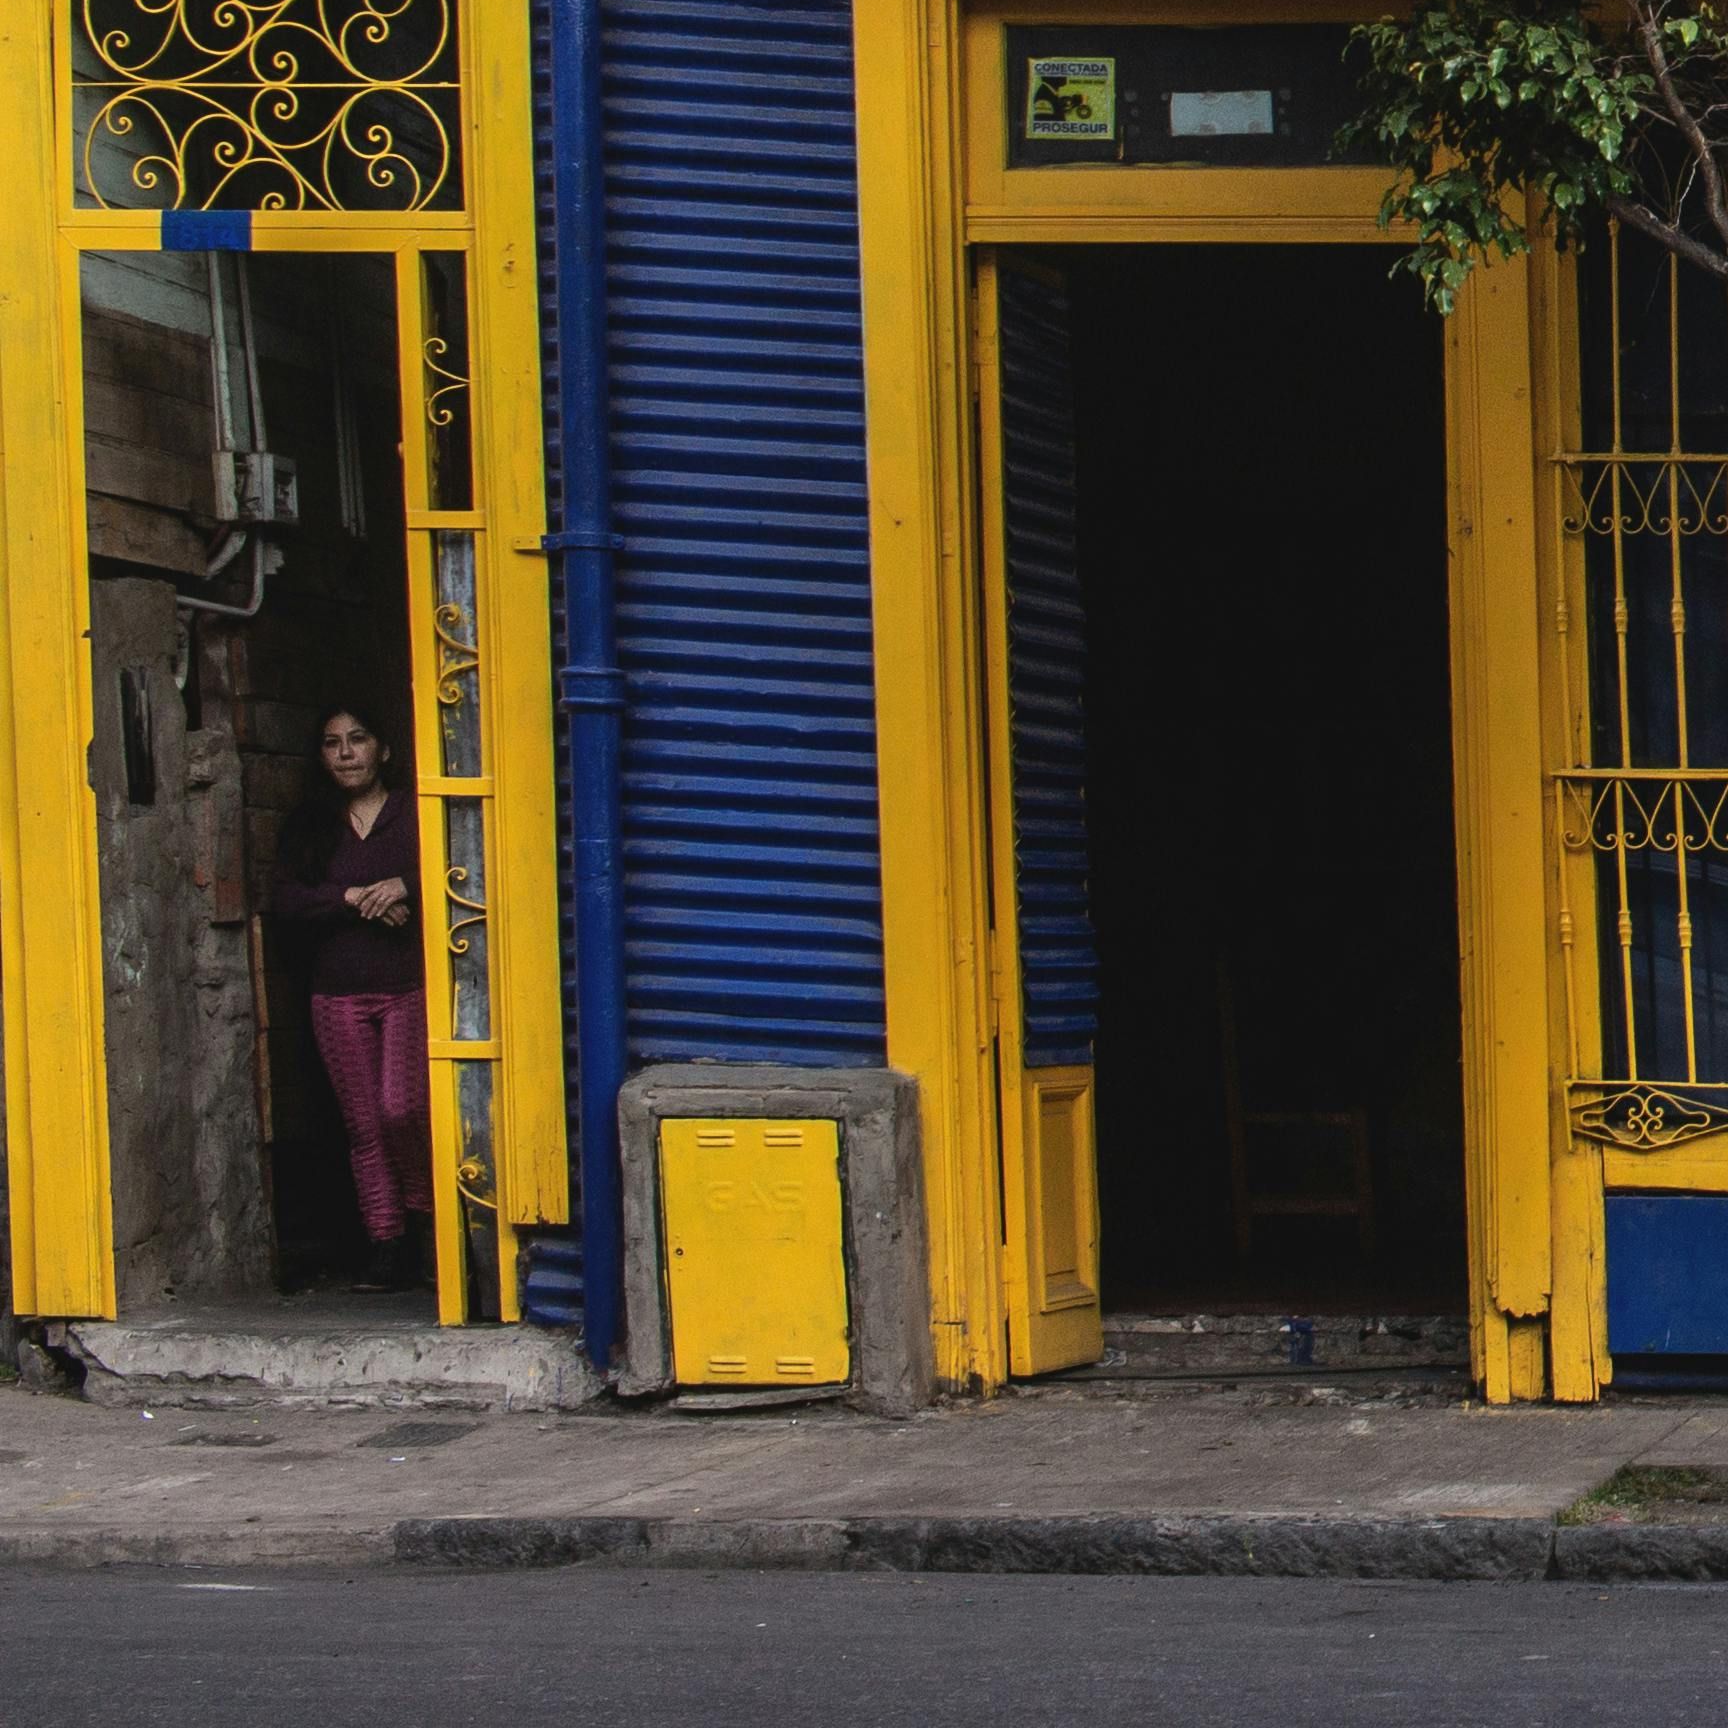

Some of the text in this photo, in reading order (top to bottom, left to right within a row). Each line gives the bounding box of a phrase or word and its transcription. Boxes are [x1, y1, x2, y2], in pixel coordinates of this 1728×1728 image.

[1034, 63, 1108, 73] CONECTADA
[1033, 122, 1108, 133] PROSEGUR
[706, 1179, 806, 1215] GAS
